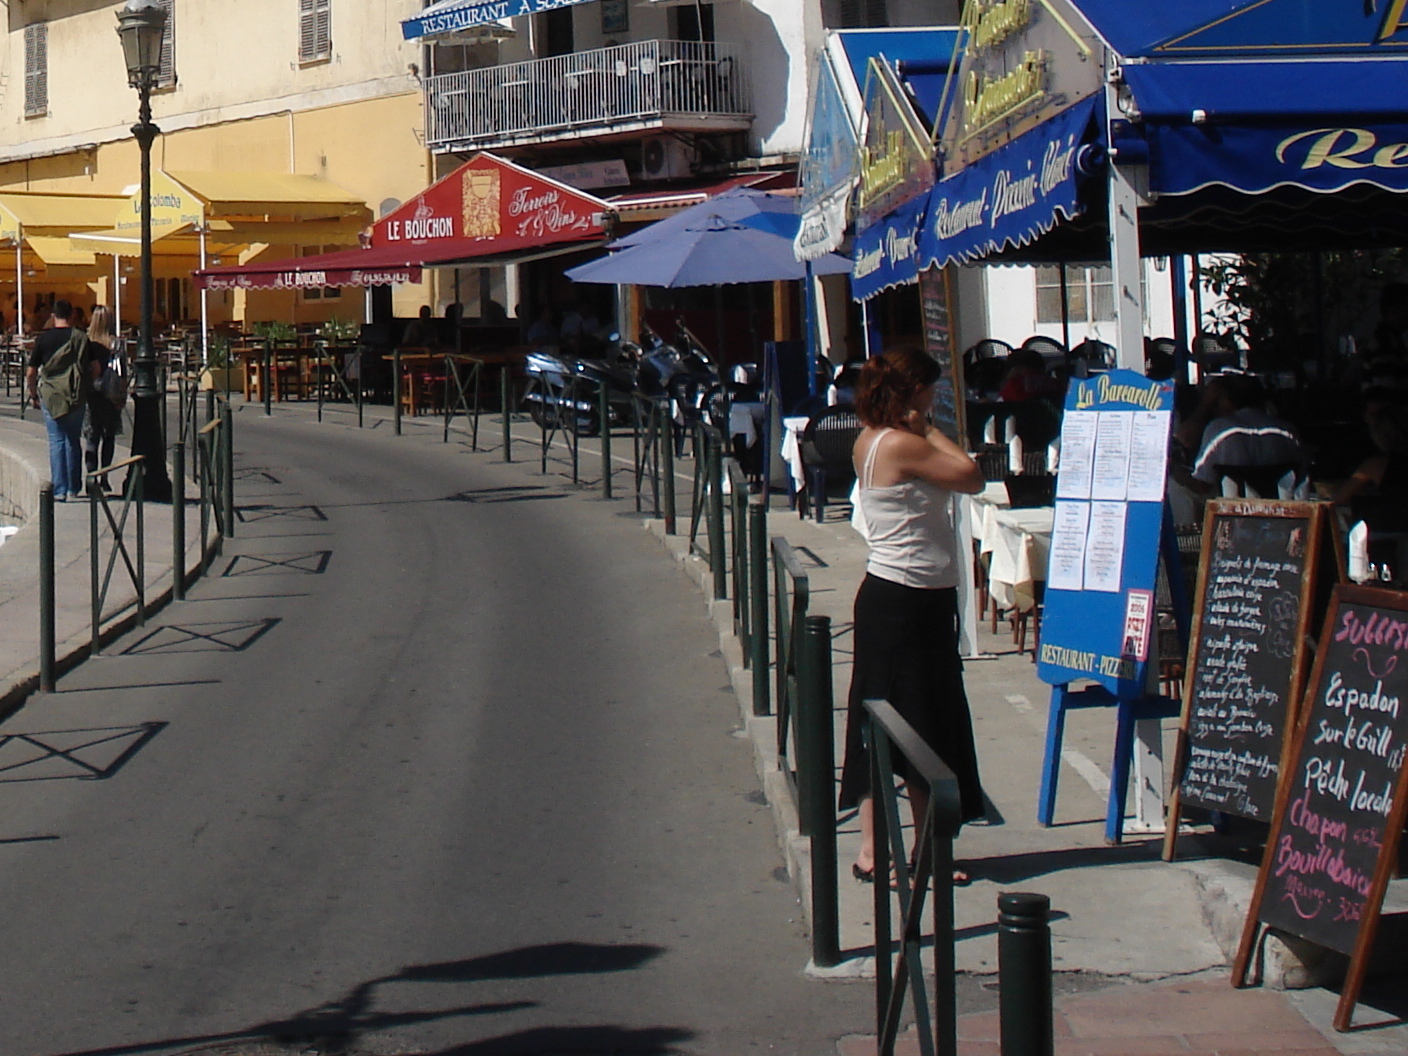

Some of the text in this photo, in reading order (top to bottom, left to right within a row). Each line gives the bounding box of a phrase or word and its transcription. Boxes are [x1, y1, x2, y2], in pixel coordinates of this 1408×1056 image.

[420, 2, 509, 35] RESTAURANT
[150, 193, 181, 209] olomba
[508, 186, 560, 217] Terroirs
[387, 217, 453, 240] LE BOUCHON
[285, 271, 326, 285] LE BOUCHON
[1076, 374, 1164, 411] La Barcarolle
[1041, 643, 1096, 673] RESTAURANT
[1325, 672, 1399, 719] Espadon
[1305, 757, 1349, 801] Pêche
[1291, 790, 1347, 843] Chapon
